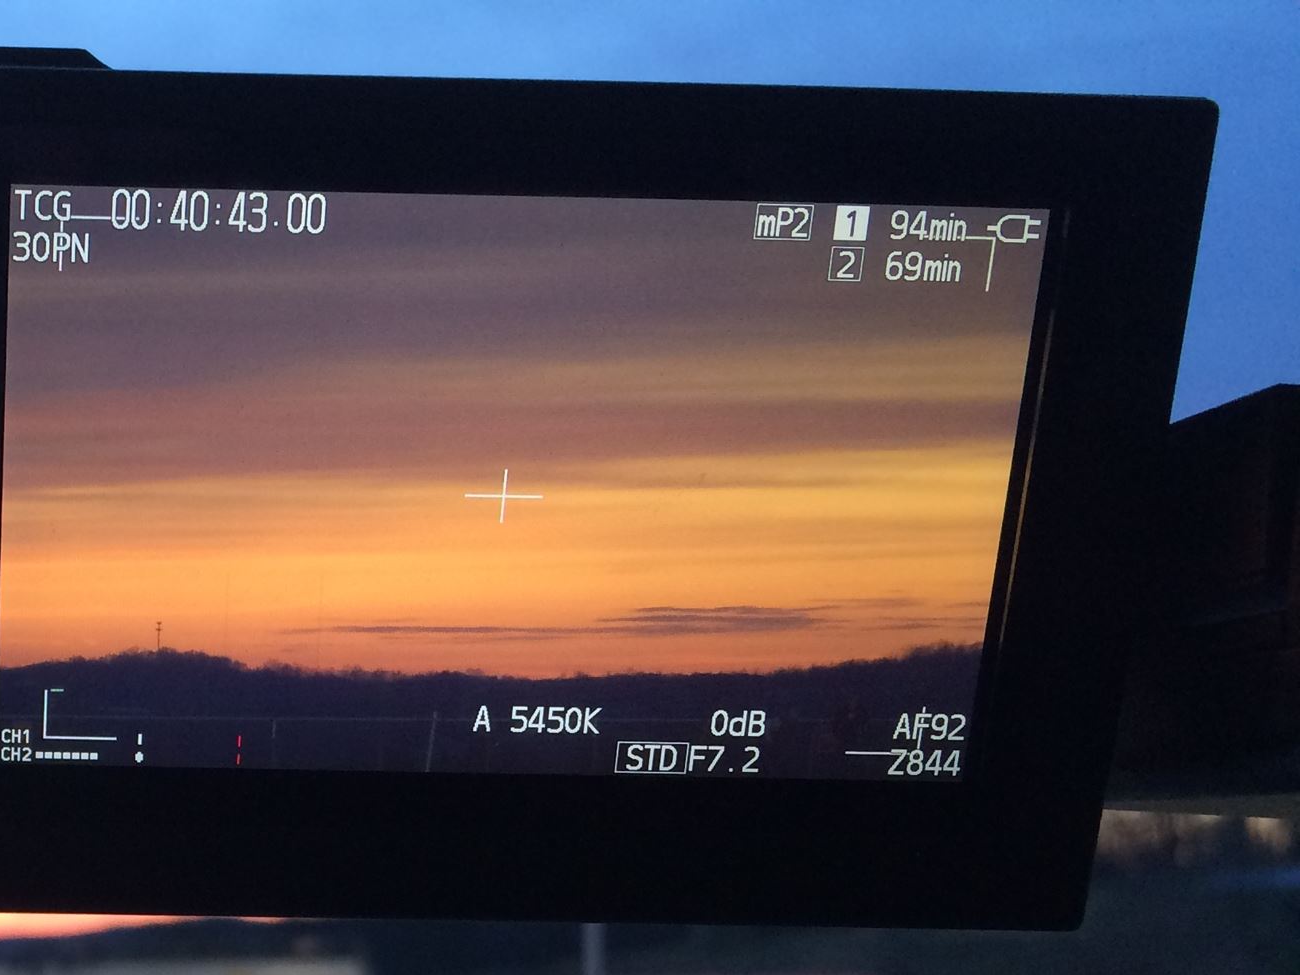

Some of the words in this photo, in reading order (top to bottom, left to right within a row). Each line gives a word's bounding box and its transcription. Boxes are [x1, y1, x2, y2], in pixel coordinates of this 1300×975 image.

[14, 189, 72, 221] TCG
[111, 188, 327, 234] 00:40:43.00
[756, 207, 810, 237] mP2
[890, 210, 967, 242] 94min
[12, 231, 89, 263] 30PN
[836, 251, 856, 279] 2
[885, 251, 961, 282] 69min
[473, 705, 491, 732] A
[510, 706, 601, 735] 5450K
[710, 710, 767, 737] 0dB
[893, 713, 967, 741] AF92
[1, 729, 30, 744] CH1
[1, 747, 32, 762] CH2
[625, 744, 679, 772] STD
[687, 745, 760, 774] F7.2
[888, 748, 961, 777] Z844
